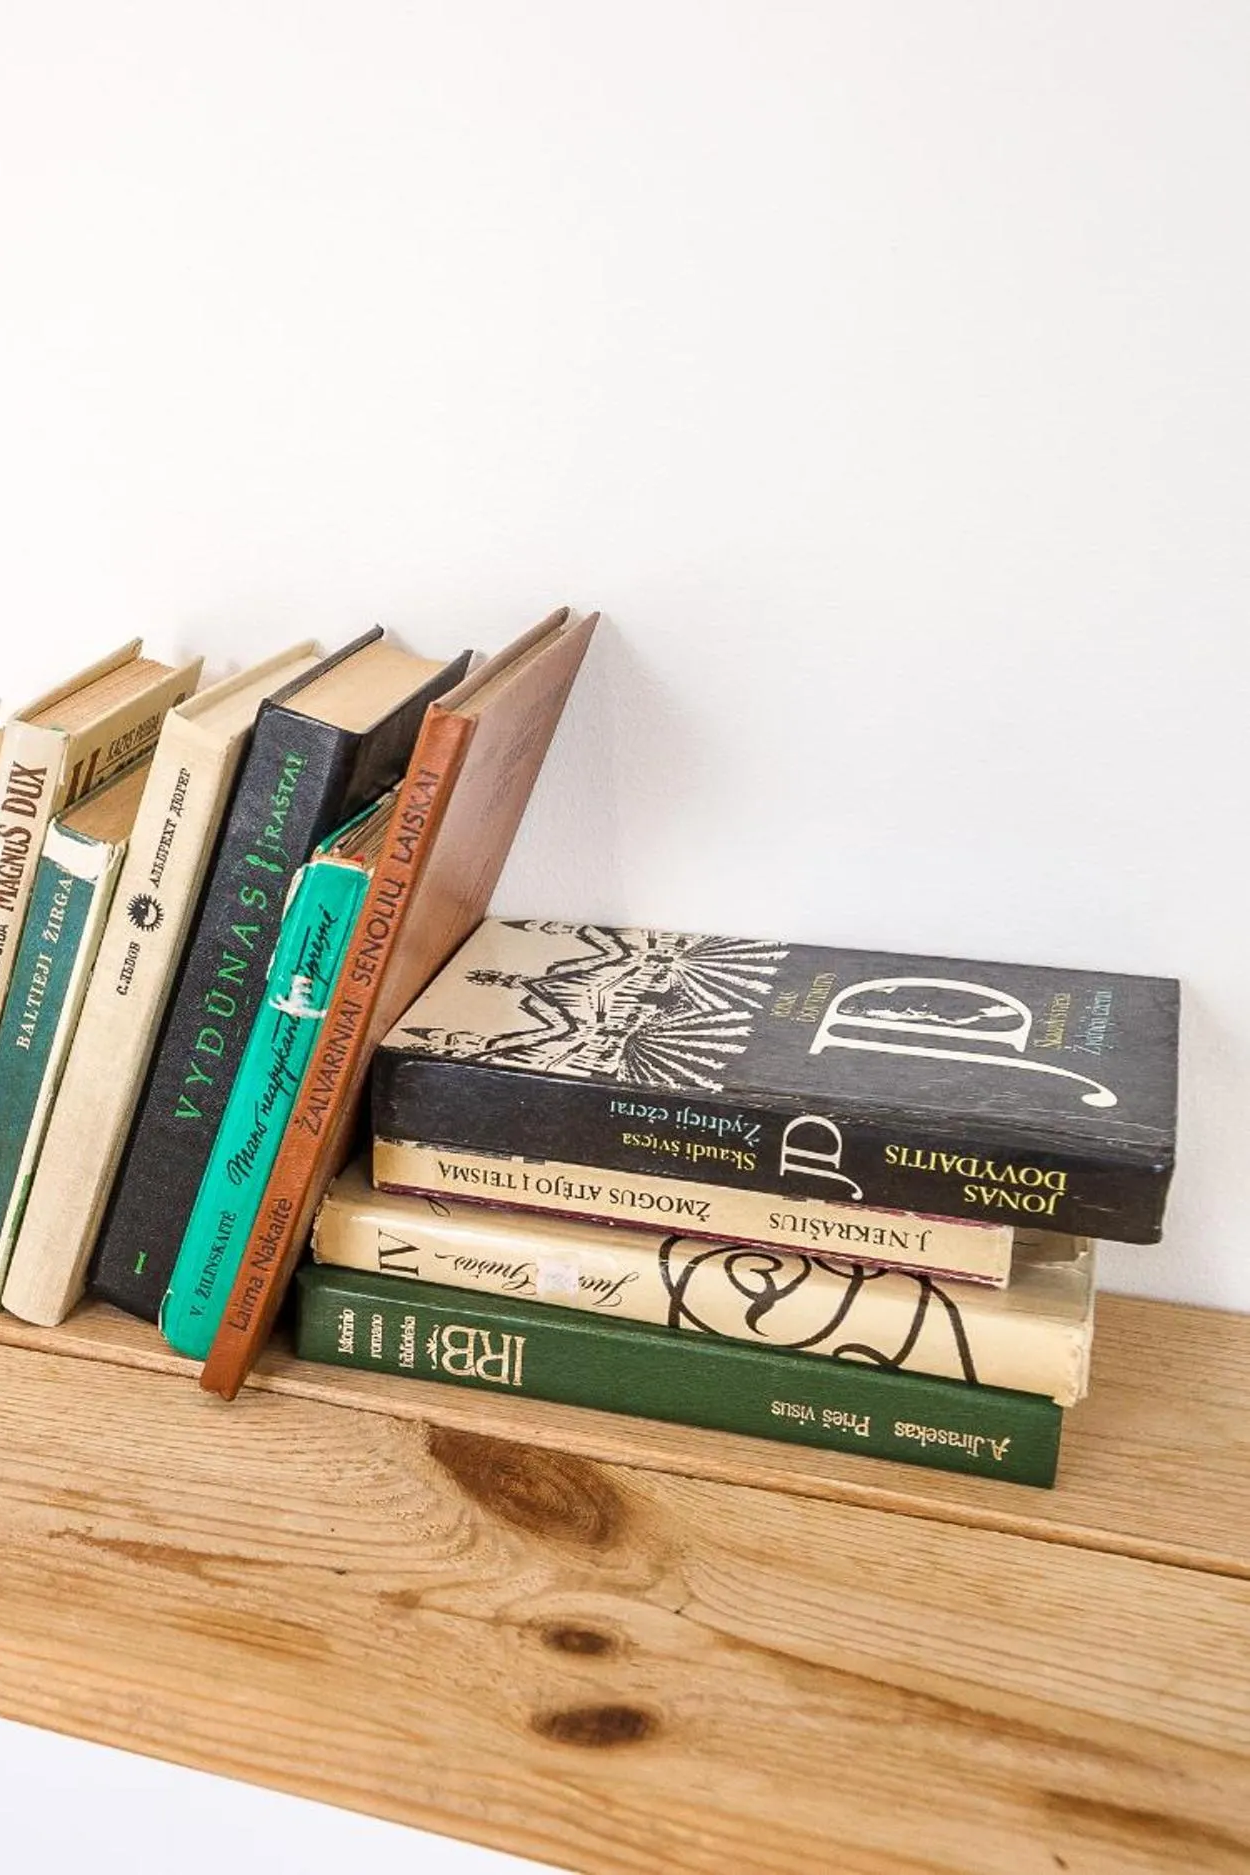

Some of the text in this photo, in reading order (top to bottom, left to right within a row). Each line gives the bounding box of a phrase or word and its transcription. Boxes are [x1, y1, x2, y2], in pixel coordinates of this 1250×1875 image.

[2, 761, 47, 818] DUX
[16, 953, 54, 1050] BALTIEJI
[174, 886, 268, 1120] VYDŪNAS
[295, 989, 364, 1136] ŽALVARINIAI
[352, 877, 406, 986] SENOLIŲ
[809, 977, 1118, 1108] JD
[228, 1103, 274, 1187] Mano
[261, 1006, 302, 1118] neapykant
[610, 1100, 762, 1147] Žydrieji ežerai
[437, 1160, 517, 1190] TEISMĄ
[622, 1132, 759, 1171] Skaudi šviesa
[779, 1113, 864, 1201] JD
[885, 1144, 1068, 1193] DOVYDAITIS
[536, 1177, 601, 1201] ATĖJO
[609, 1188, 711, 1222] ŽMOGUS
[963, 1183, 1067, 1215] JONAS
[378, 1228, 420, 1276] IV
[769, 1212, 932, 1251] J. NEKRAŠIUS
[434, 1250, 539, 1296] Grušas
[229, 1272, 265, 1333] Laima
[441, 1324, 526, 1387] IRB
[771, 1400, 815, 1427] visus
[823, 1407, 871, 1438] Prieš
